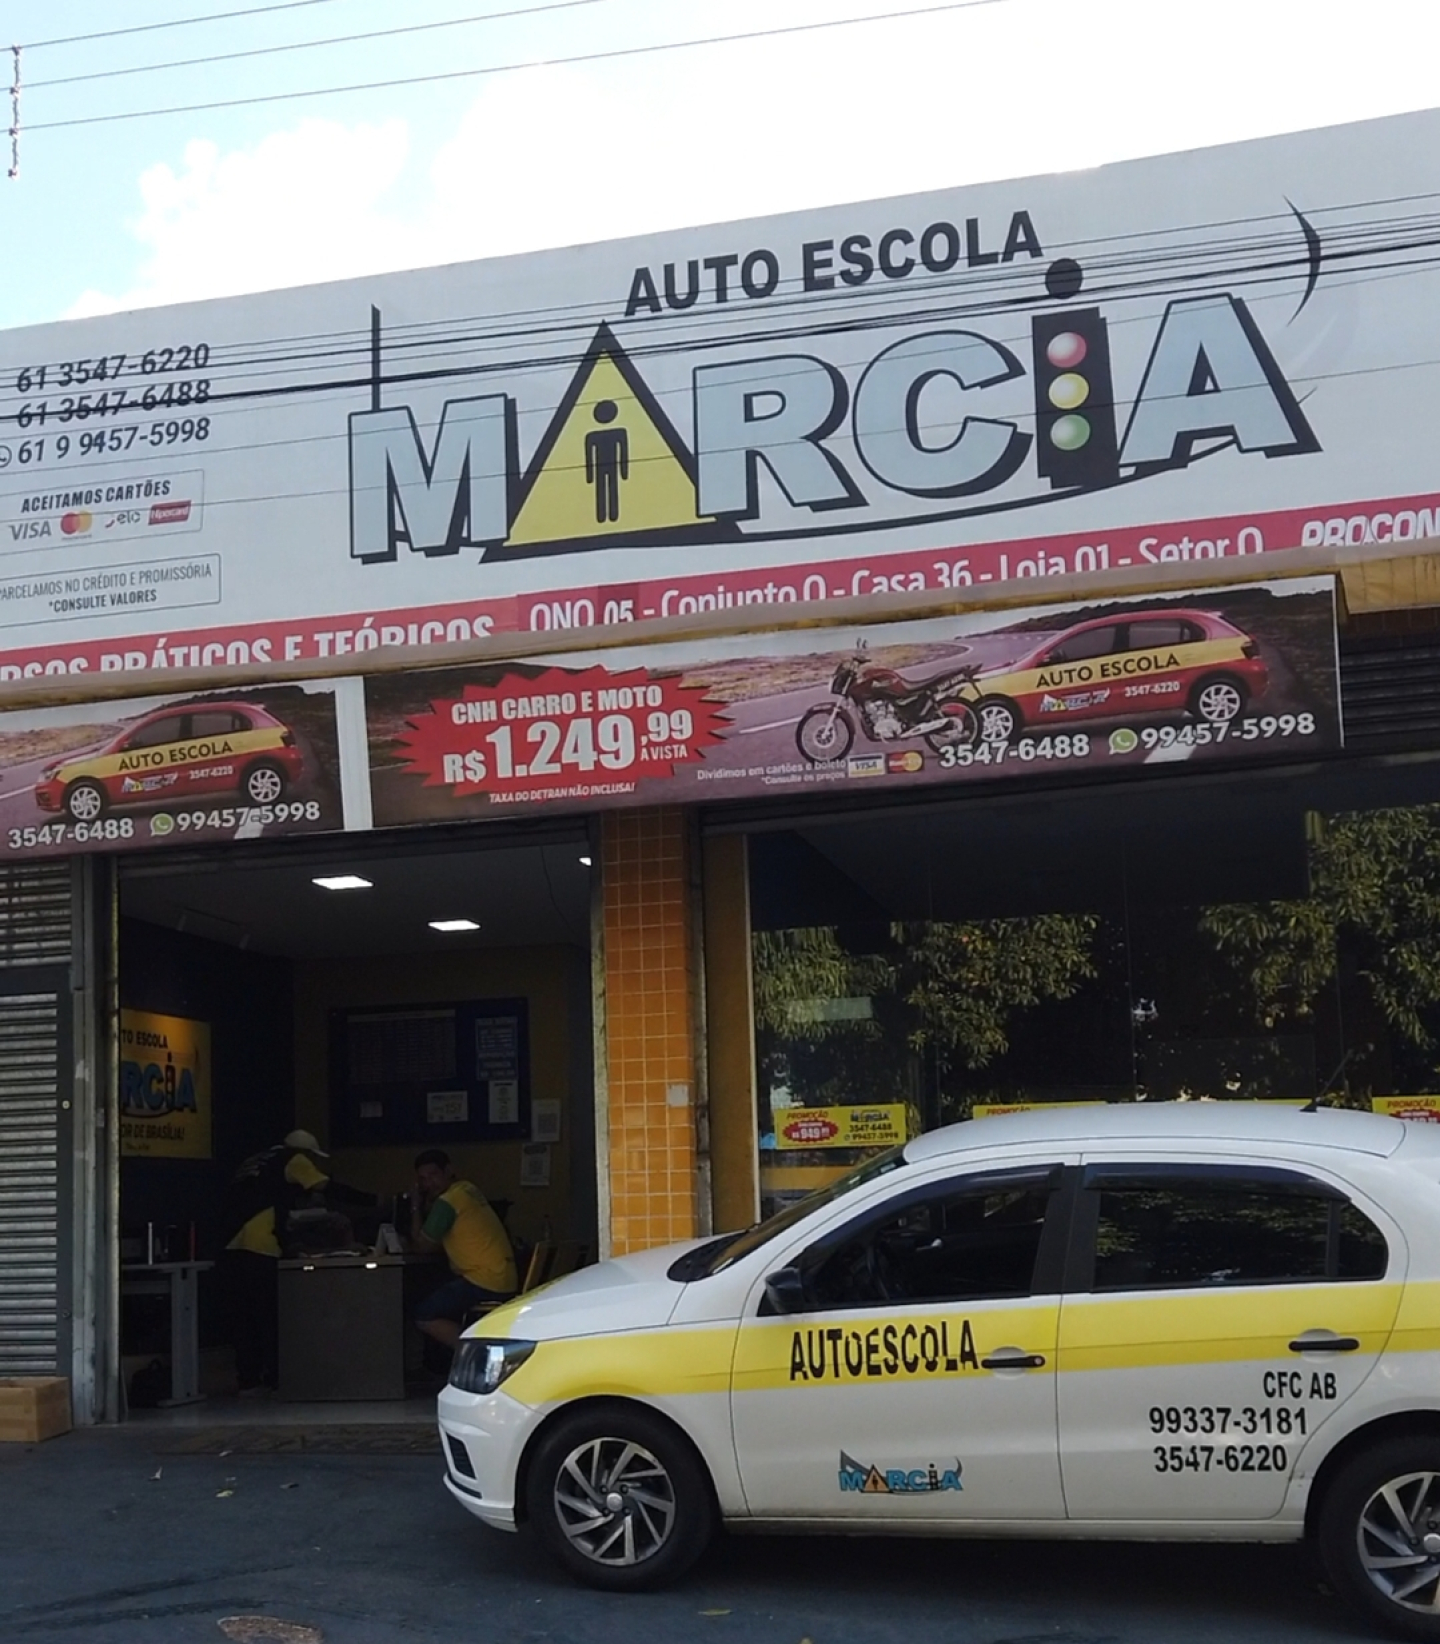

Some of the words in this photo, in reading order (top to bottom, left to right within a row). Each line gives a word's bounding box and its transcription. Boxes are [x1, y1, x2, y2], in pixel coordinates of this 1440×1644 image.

[624, 248, 779, 317] AUTO
[802, 210, 1043, 292] ESCOLA
[17, 366, 47, 392] 61
[58, 343, 210, 387] 3547-6220
[17, 402, 48, 428] 61
[58, 379, 211, 422] 3547-6488
[18, 438, 45, 464] 61
[56, 435, 70, 460] 9
[79, 417, 211, 456] 9457-5998
[21, 488, 102, 513] ACEITAMOS
[105, 479, 171, 502] CARTÕES
[9, 521, 52, 541] VISA
[65, 578, 80, 593] NO
[83, 572, 127, 590] CRÉDITO
[130, 571, 137, 583] E
[139, 563, 212, 585] PROMISSÓRIA
[109, 589, 157, 606] VALORES
[1036, 666, 1093, 688] AUTO
[1100, 653, 1180, 679] ESCOLA
[452, 702, 497, 725] CNH
[502, 692, 575, 719] CARRO
[581, 691, 593, 713] E
[598, 685, 662, 711] MOTO
[1125, 681, 1181, 697] 3547-6220
[1142, 712, 1316, 750] 99457-5998
[119, 751, 164, 772] AUTO
[170, 740, 233, 763] ESCOLA
[443, 750, 486, 783] R$
[650, 745, 688, 760] VISTA
[940, 733, 1090, 768] 3547-6488
[697, 768, 746, 780] Dividimos
[749, 766, 764, 775] em
[766, 762, 802, 774] cartões
[805, 763, 812, 771] e
[815, 760, 847, 771] boleto
[489, 793, 514, 803] TAXA
[515, 791, 529, 801] DO
[530, 787, 568, 800] DETRAN
[569, 784, 589, 797] NÃO
[177, 801, 321, 832] 99457-5998
[8, 817, 134, 849] 3547-6488
[136, 1031, 168, 1049] ESCOLA
[790, 1320, 979, 1381] AUTOESCOLA
[1263, 1371, 1302, 1398] CFC
[1309, 1372, 1337, 1399] AB
[1150, 1406, 1307, 1435] 99337-3181
[1153, 1444, 1287, 1472] 3547-6220
